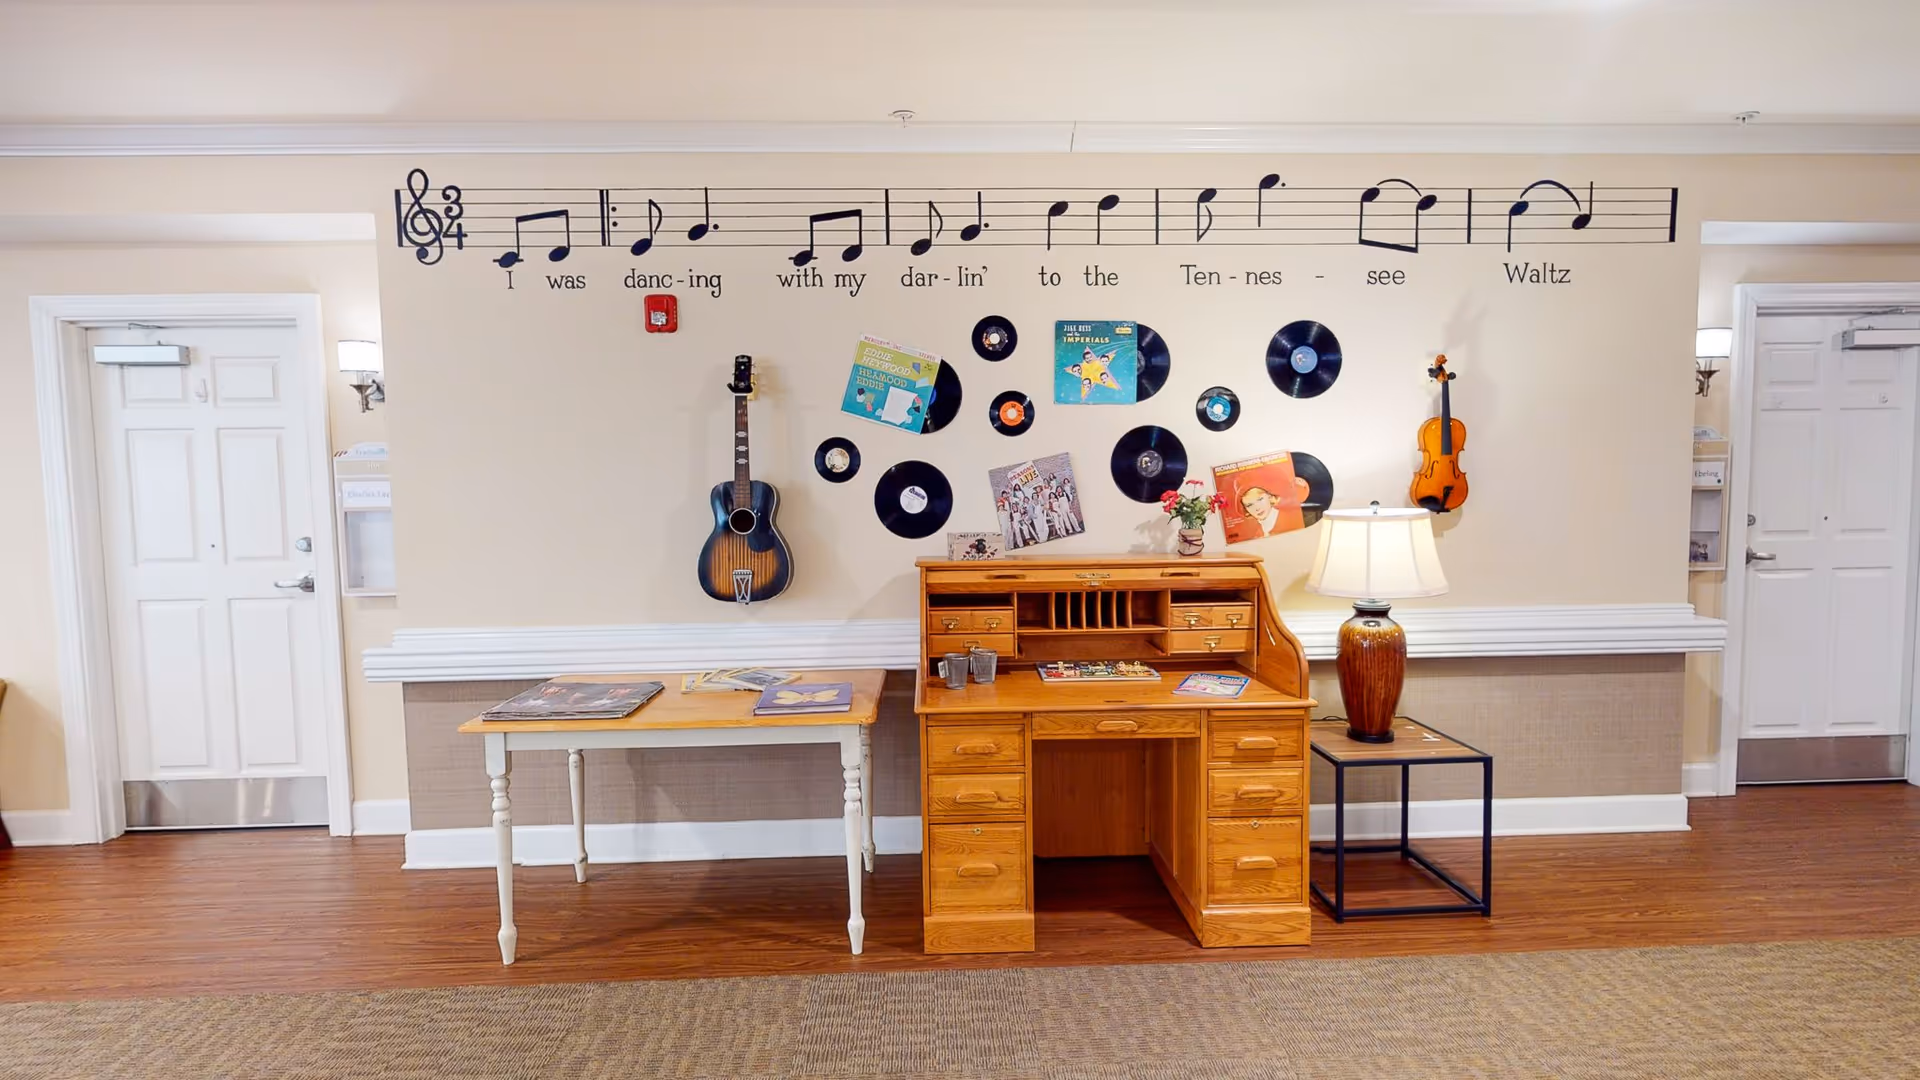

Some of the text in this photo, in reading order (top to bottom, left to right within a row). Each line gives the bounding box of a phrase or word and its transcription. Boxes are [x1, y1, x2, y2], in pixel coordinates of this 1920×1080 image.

[508, 270, 516, 290] I
[546, 275, 586, 290] was
[776, 267, 824, 289] with
[834, 273, 867, 299] my
[1039, 265, 1061, 287] to
[1083, 265, 1119, 287] the
[1366, 270, 1405, 286] see
[1503, 262, 1571, 285] Waltz
[1063, 336, 1111, 344] IMPERIALS
[863, 347, 894, 362] EDDIE
[861, 355, 912, 376] HEYWOOD
